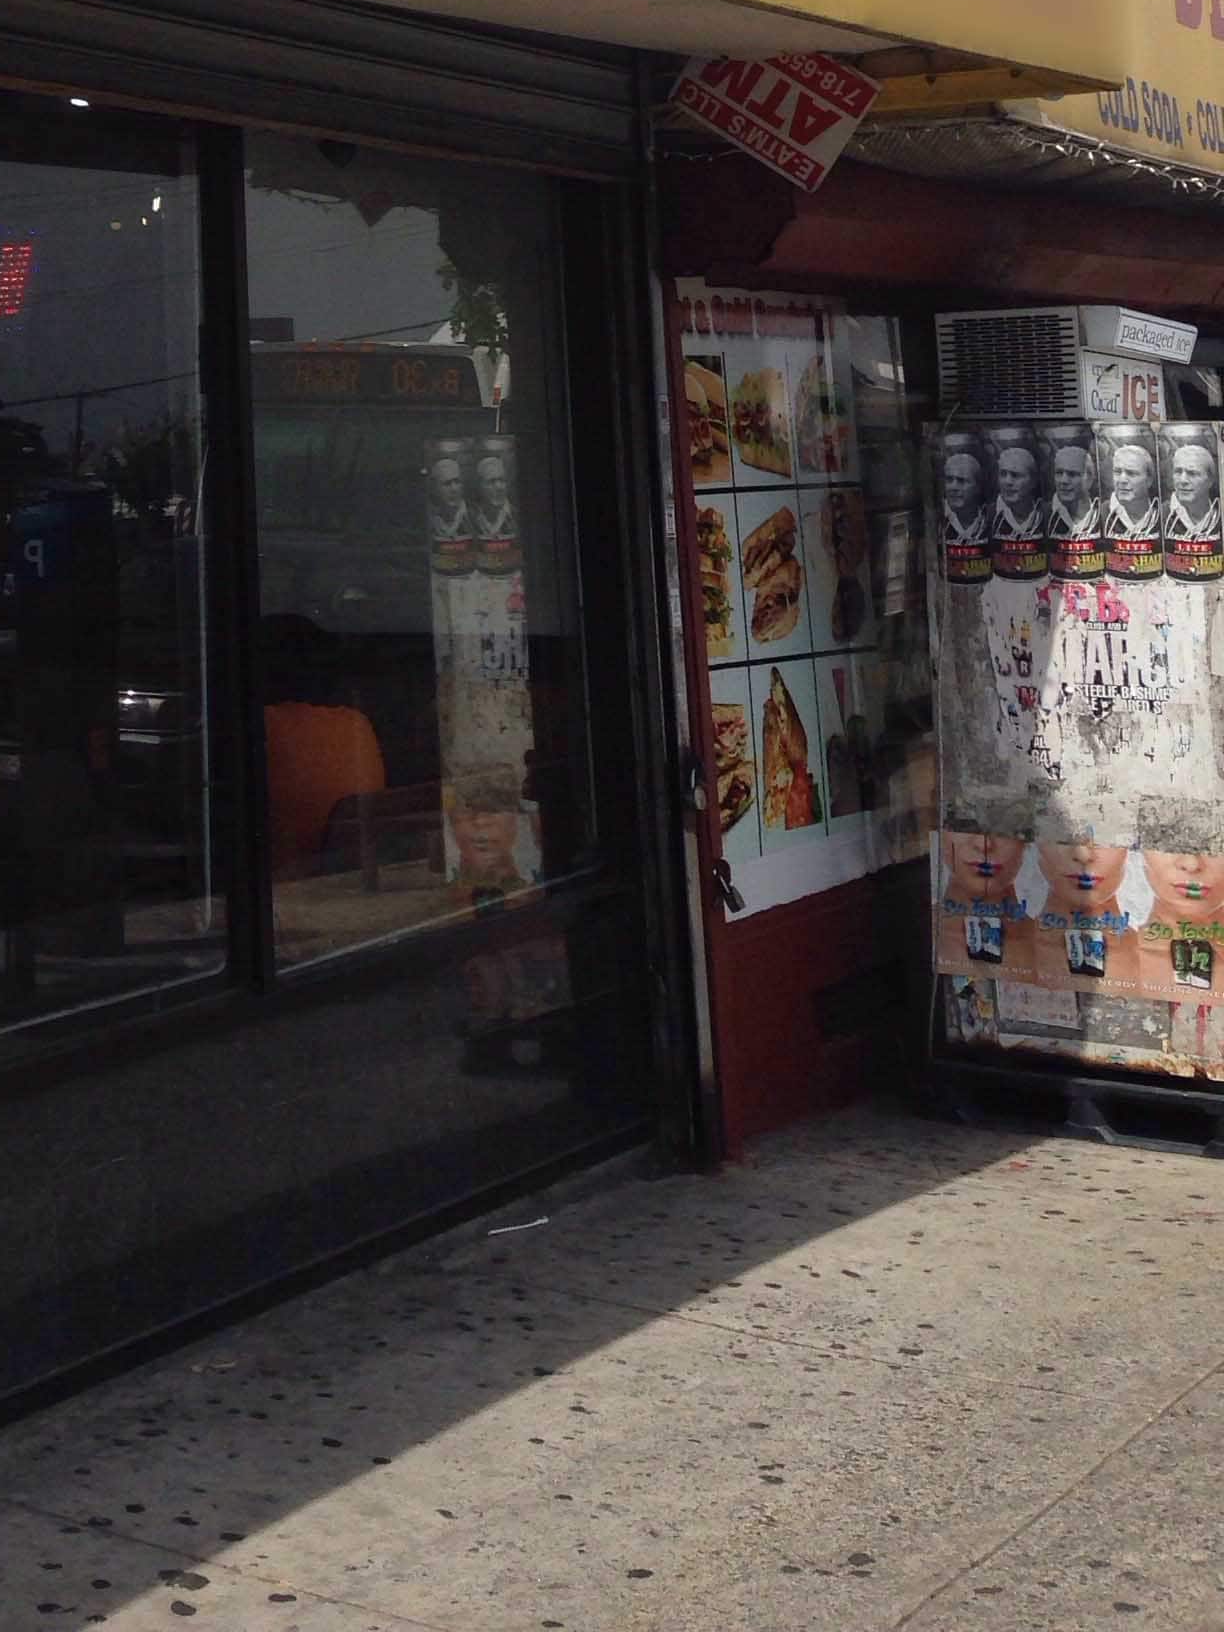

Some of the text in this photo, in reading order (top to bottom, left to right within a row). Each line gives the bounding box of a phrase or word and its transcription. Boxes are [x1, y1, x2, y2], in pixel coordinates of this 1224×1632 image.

[680, 84, 722, 119] LLC
[698, 59, 846, 147] ATM
[1141, 80, 1185, 150] SODA
[1120, 324, 1176, 351] packaged
[1122, 373, 1161, 422] ICE
[1059, 541, 1091, 551] LITE
[1117, 542, 1148, 551] LITE
[1177, 543, 1209, 553] LITE
[1069, 911, 1130, 935] Tasty!
